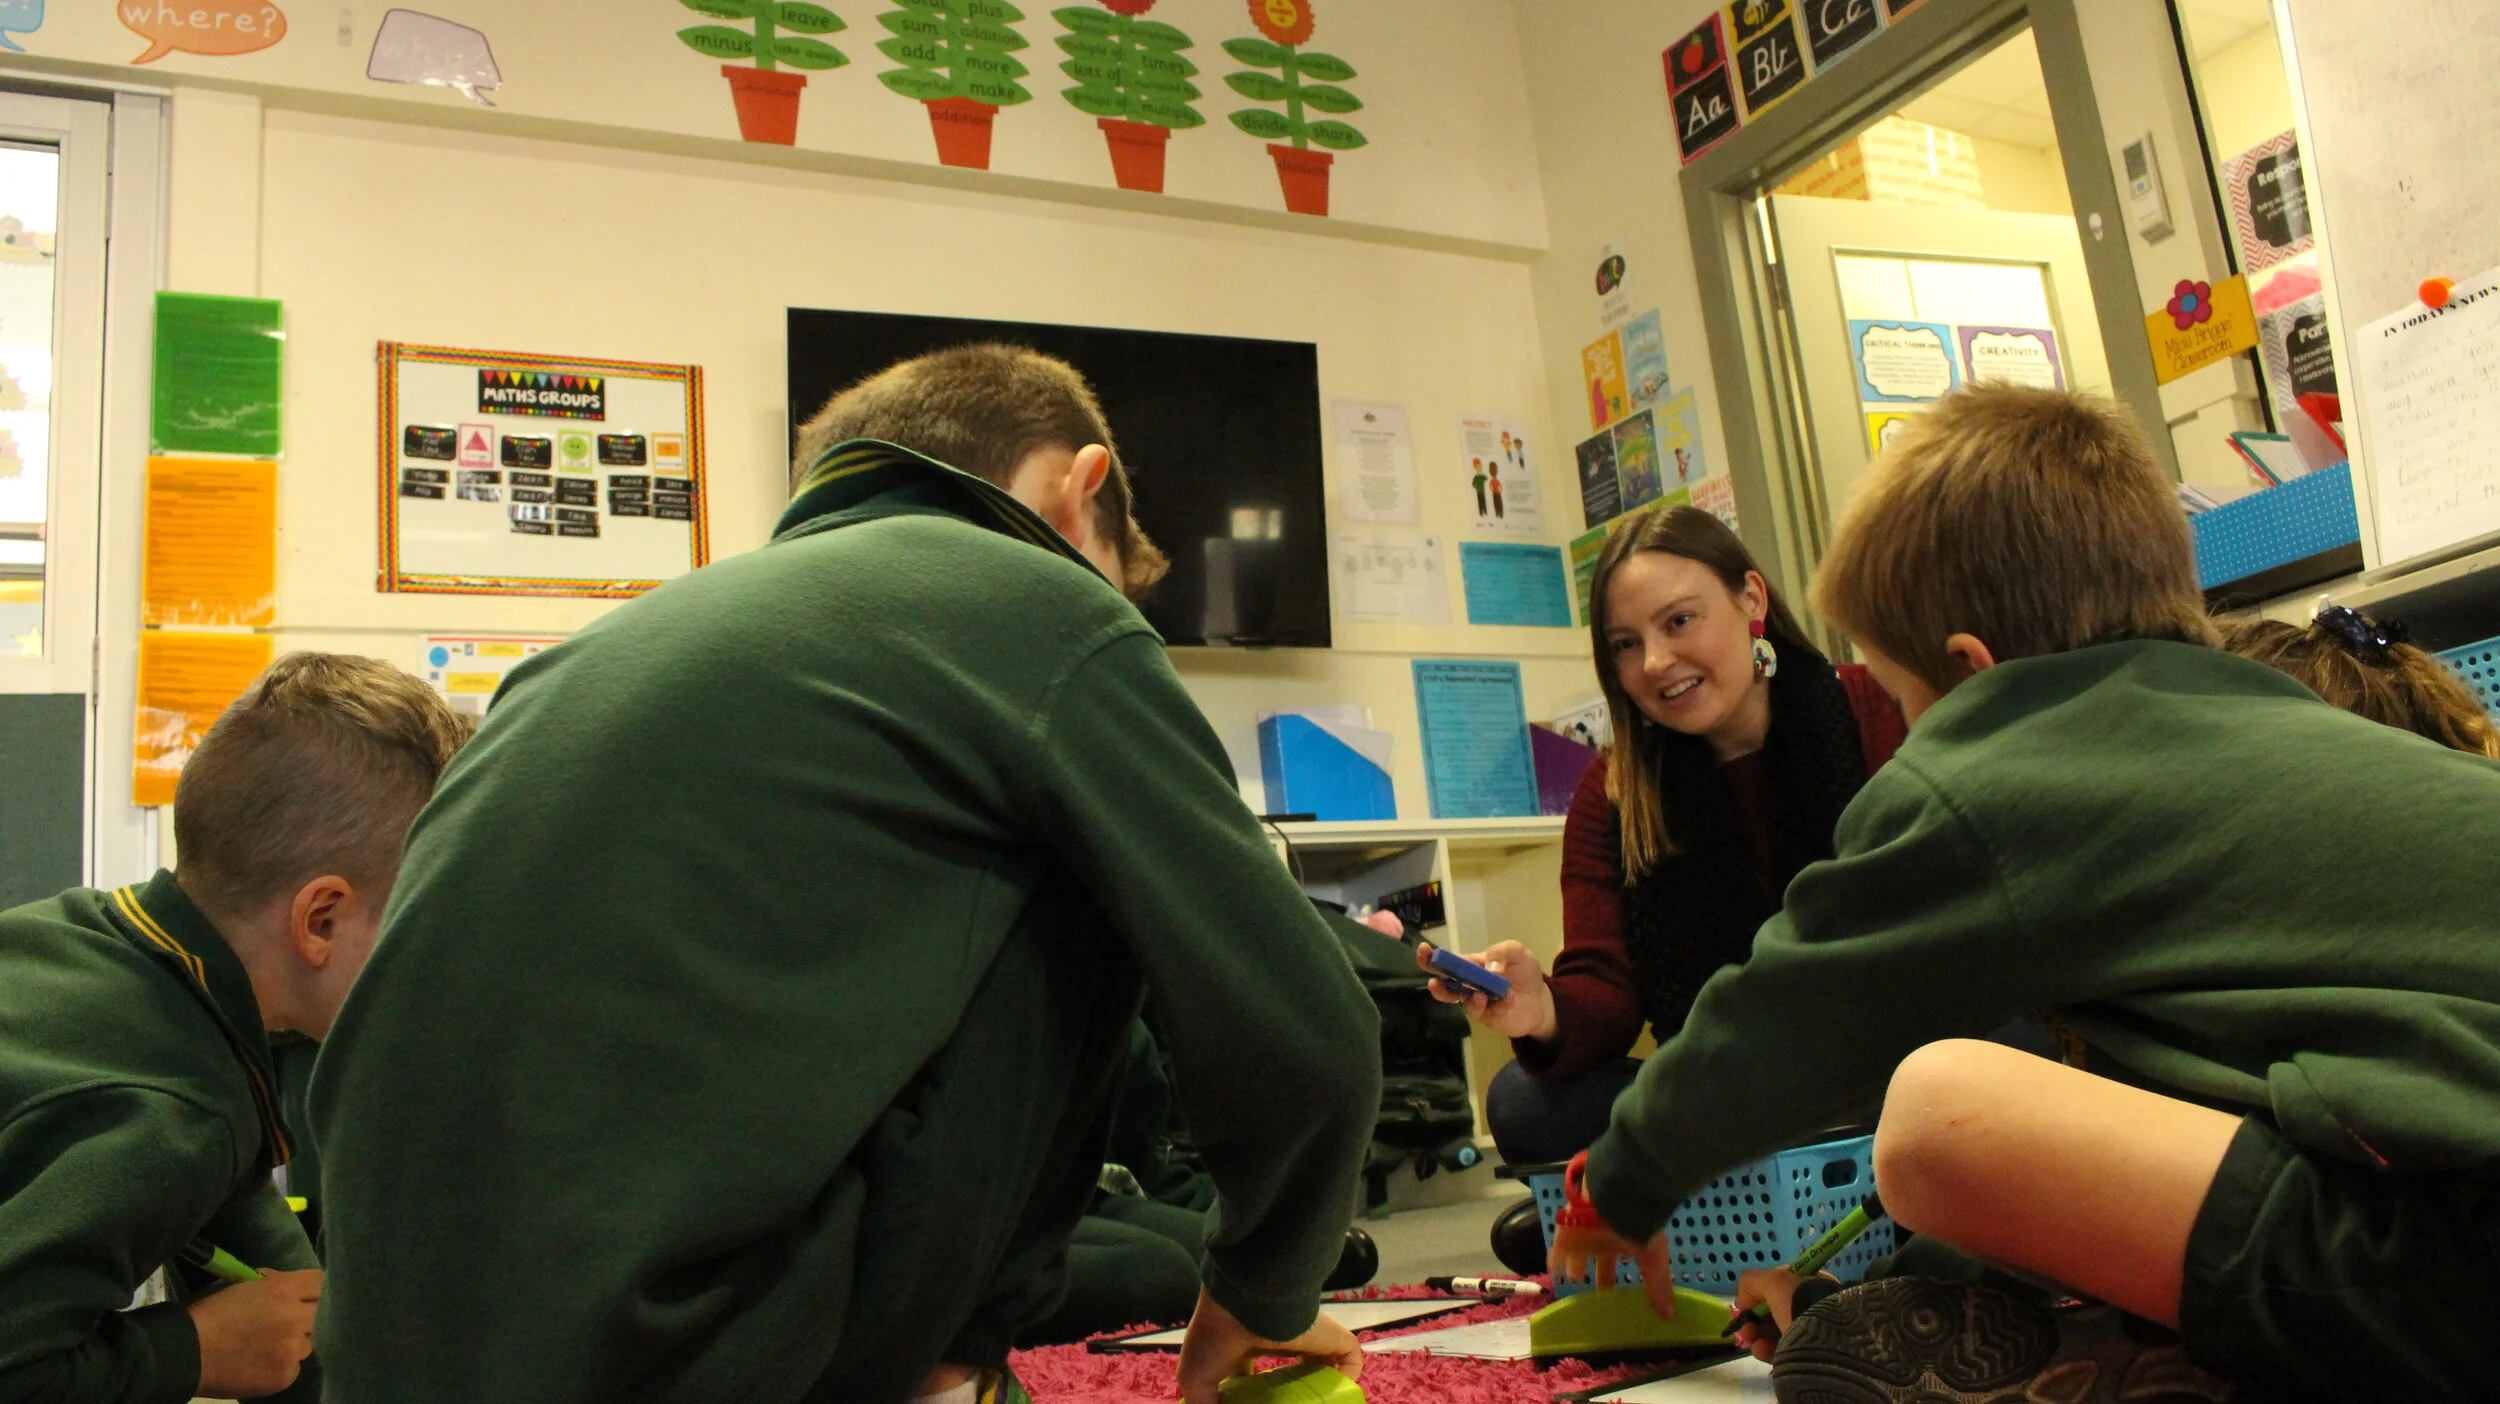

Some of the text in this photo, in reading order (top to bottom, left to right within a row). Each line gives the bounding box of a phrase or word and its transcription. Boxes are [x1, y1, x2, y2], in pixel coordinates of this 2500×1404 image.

[124, 0, 279, 37] where?
[782, 4, 830, 28] leave
[969, 1, 1003, 19] plus
[902, 18, 939, 36] sum
[961, 26, 1020, 48] addition
[694, 33, 752, 54] minus
[902, 43, 937, 61] add
[966, 55, 1011, 75] more
[1142, 55, 1185, 75] times
[1754, 38, 1788, 89] Bb
[1074, 63, 1122, 85] lots of
[970, 82, 1016, 100] make
[931, 110, 992, 127] addition
[1242, 113, 1289, 132] divide
[1687, 94, 1728, 137] Aa
[1313, 125, 1354, 142] share
[1865, 340, 1902, 349] CRITICAL
[1979, 346, 2039, 358] CREATIVITY
[483, 387, 601, 409] MATHS GROUPS
